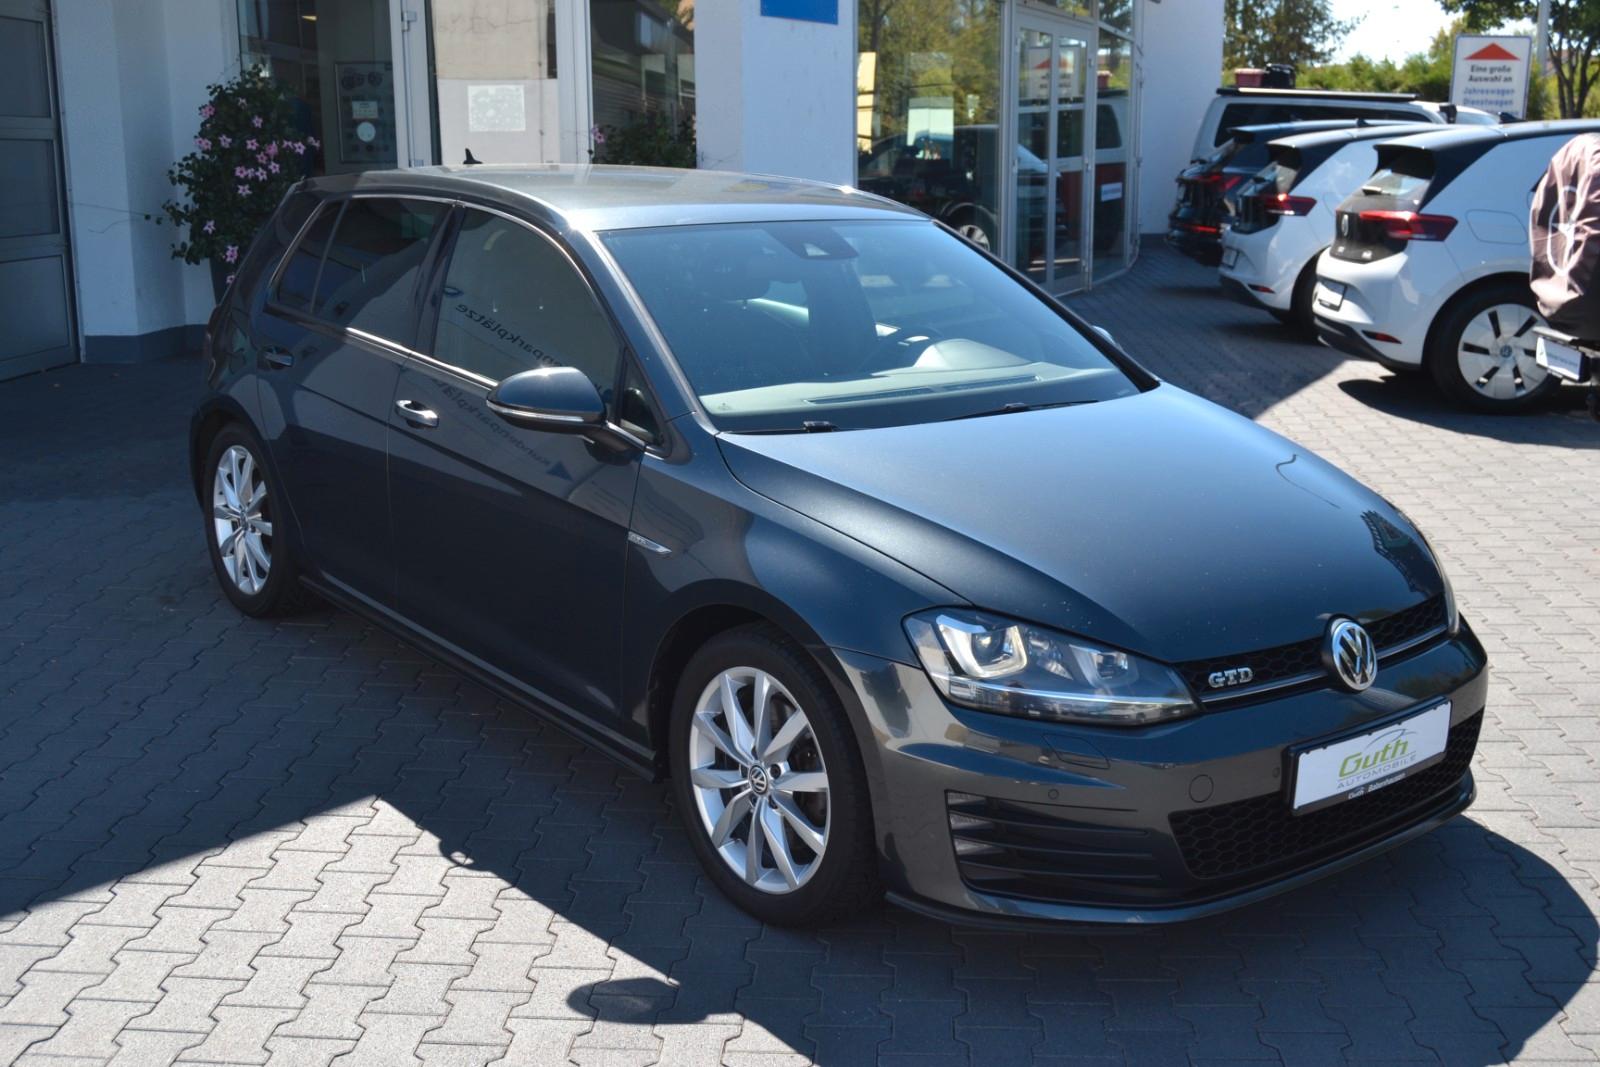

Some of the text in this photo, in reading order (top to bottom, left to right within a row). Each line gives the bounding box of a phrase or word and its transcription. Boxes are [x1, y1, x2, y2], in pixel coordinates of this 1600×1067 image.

[1471, 65, 1512, 74] Eine große
[1208, 667, 1253, 688] GTD
[1336, 754, 1417, 789] AUTOMOBILE
[1338, 739, 1409, 778] Guth
